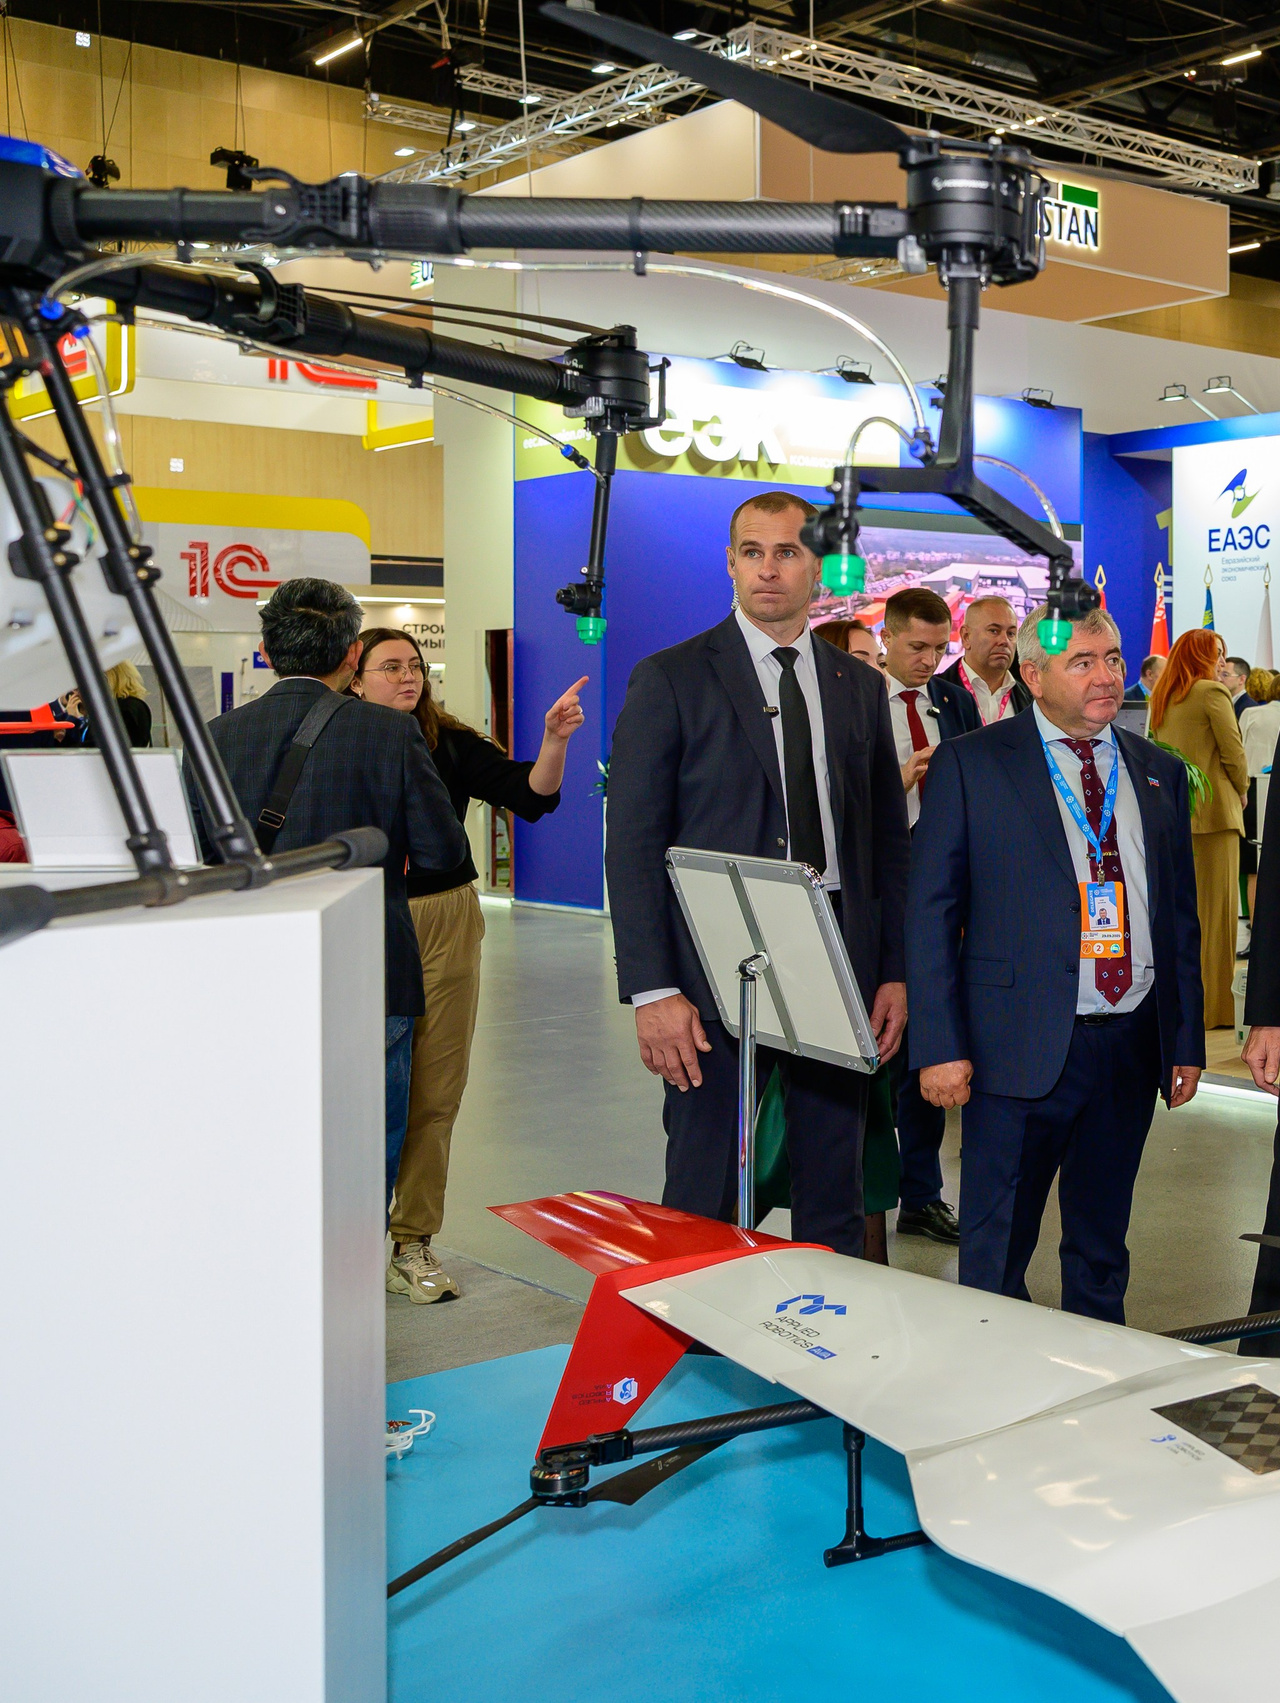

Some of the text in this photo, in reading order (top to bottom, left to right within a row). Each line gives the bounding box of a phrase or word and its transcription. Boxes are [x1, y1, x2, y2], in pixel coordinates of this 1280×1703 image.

[1208, 524, 1271, 552] ЕАЭС
[759, 1320, 814, 1349] ROBOTICS
[775, 1315, 820, 1338] APPLIED
